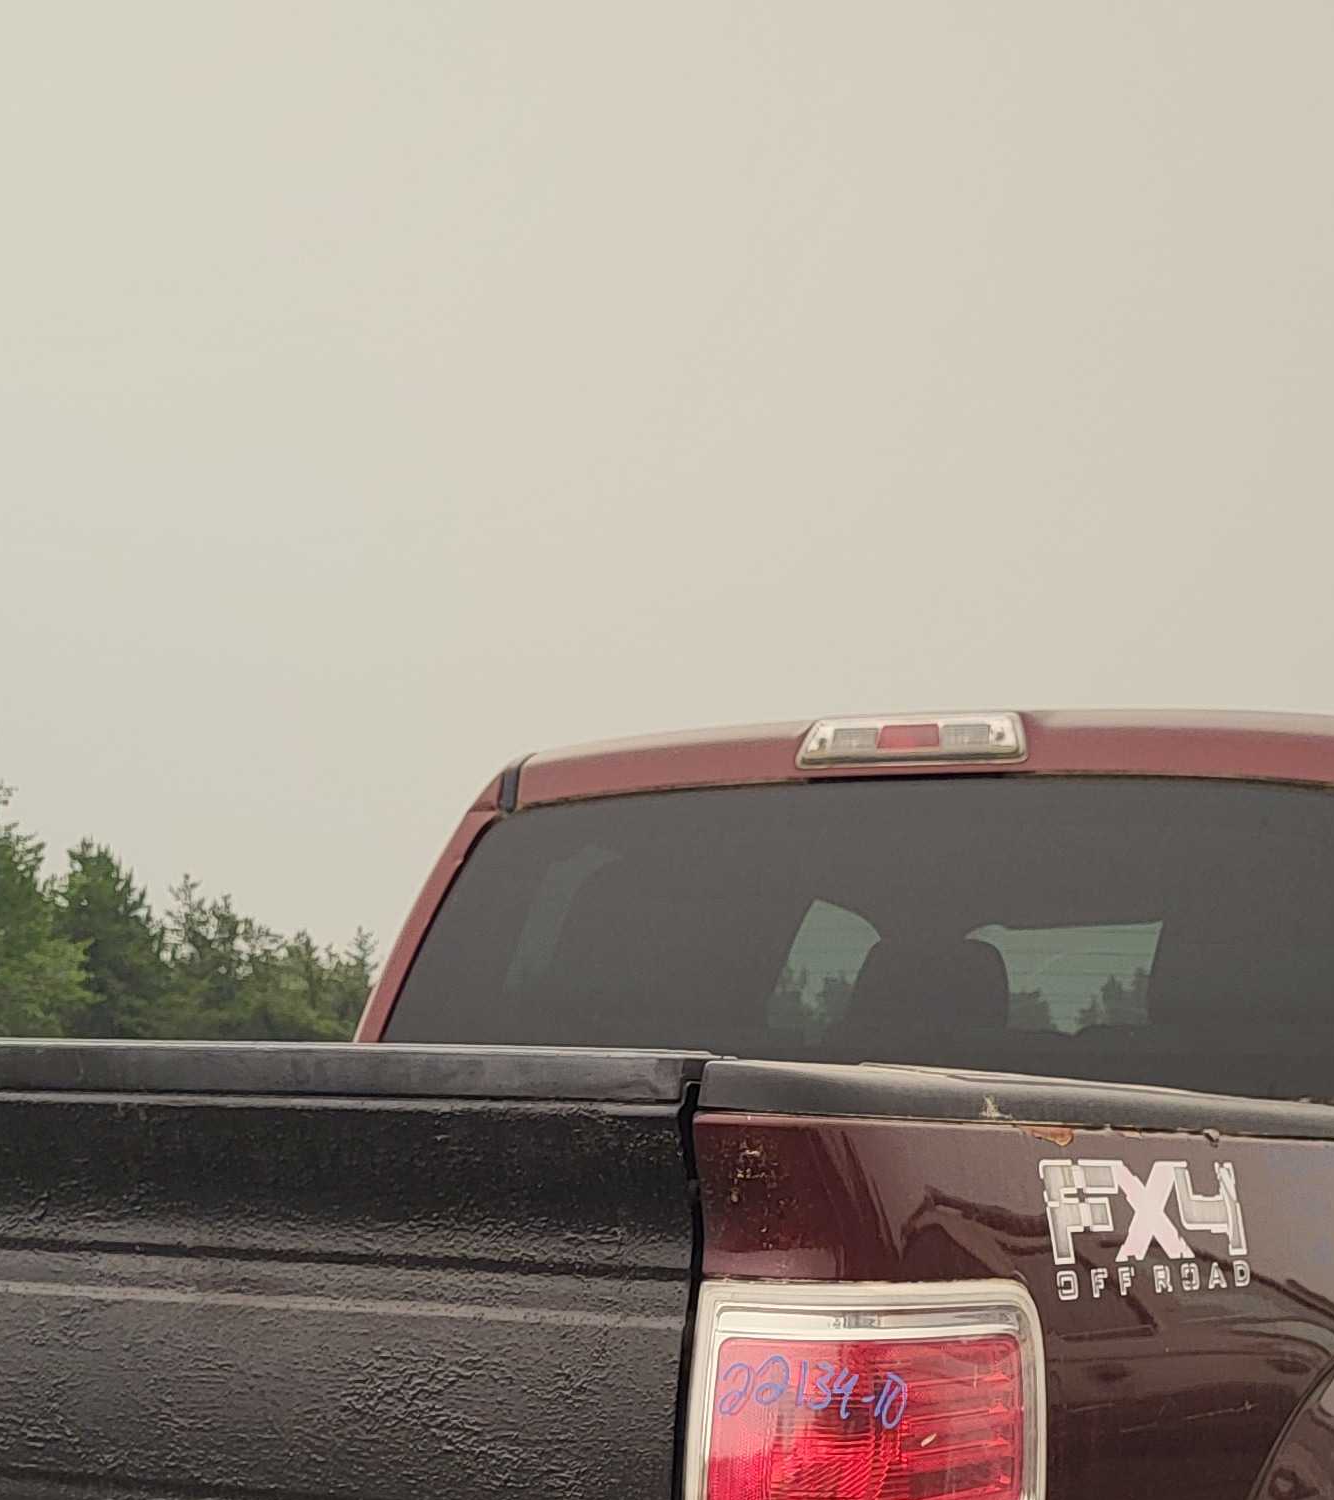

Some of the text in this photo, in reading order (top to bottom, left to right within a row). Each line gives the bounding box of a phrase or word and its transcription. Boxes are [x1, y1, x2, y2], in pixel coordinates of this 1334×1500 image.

[1038, 1159, 1249, 1265] FX4
[1056, 1259, 1252, 1301] OFF ROAD
